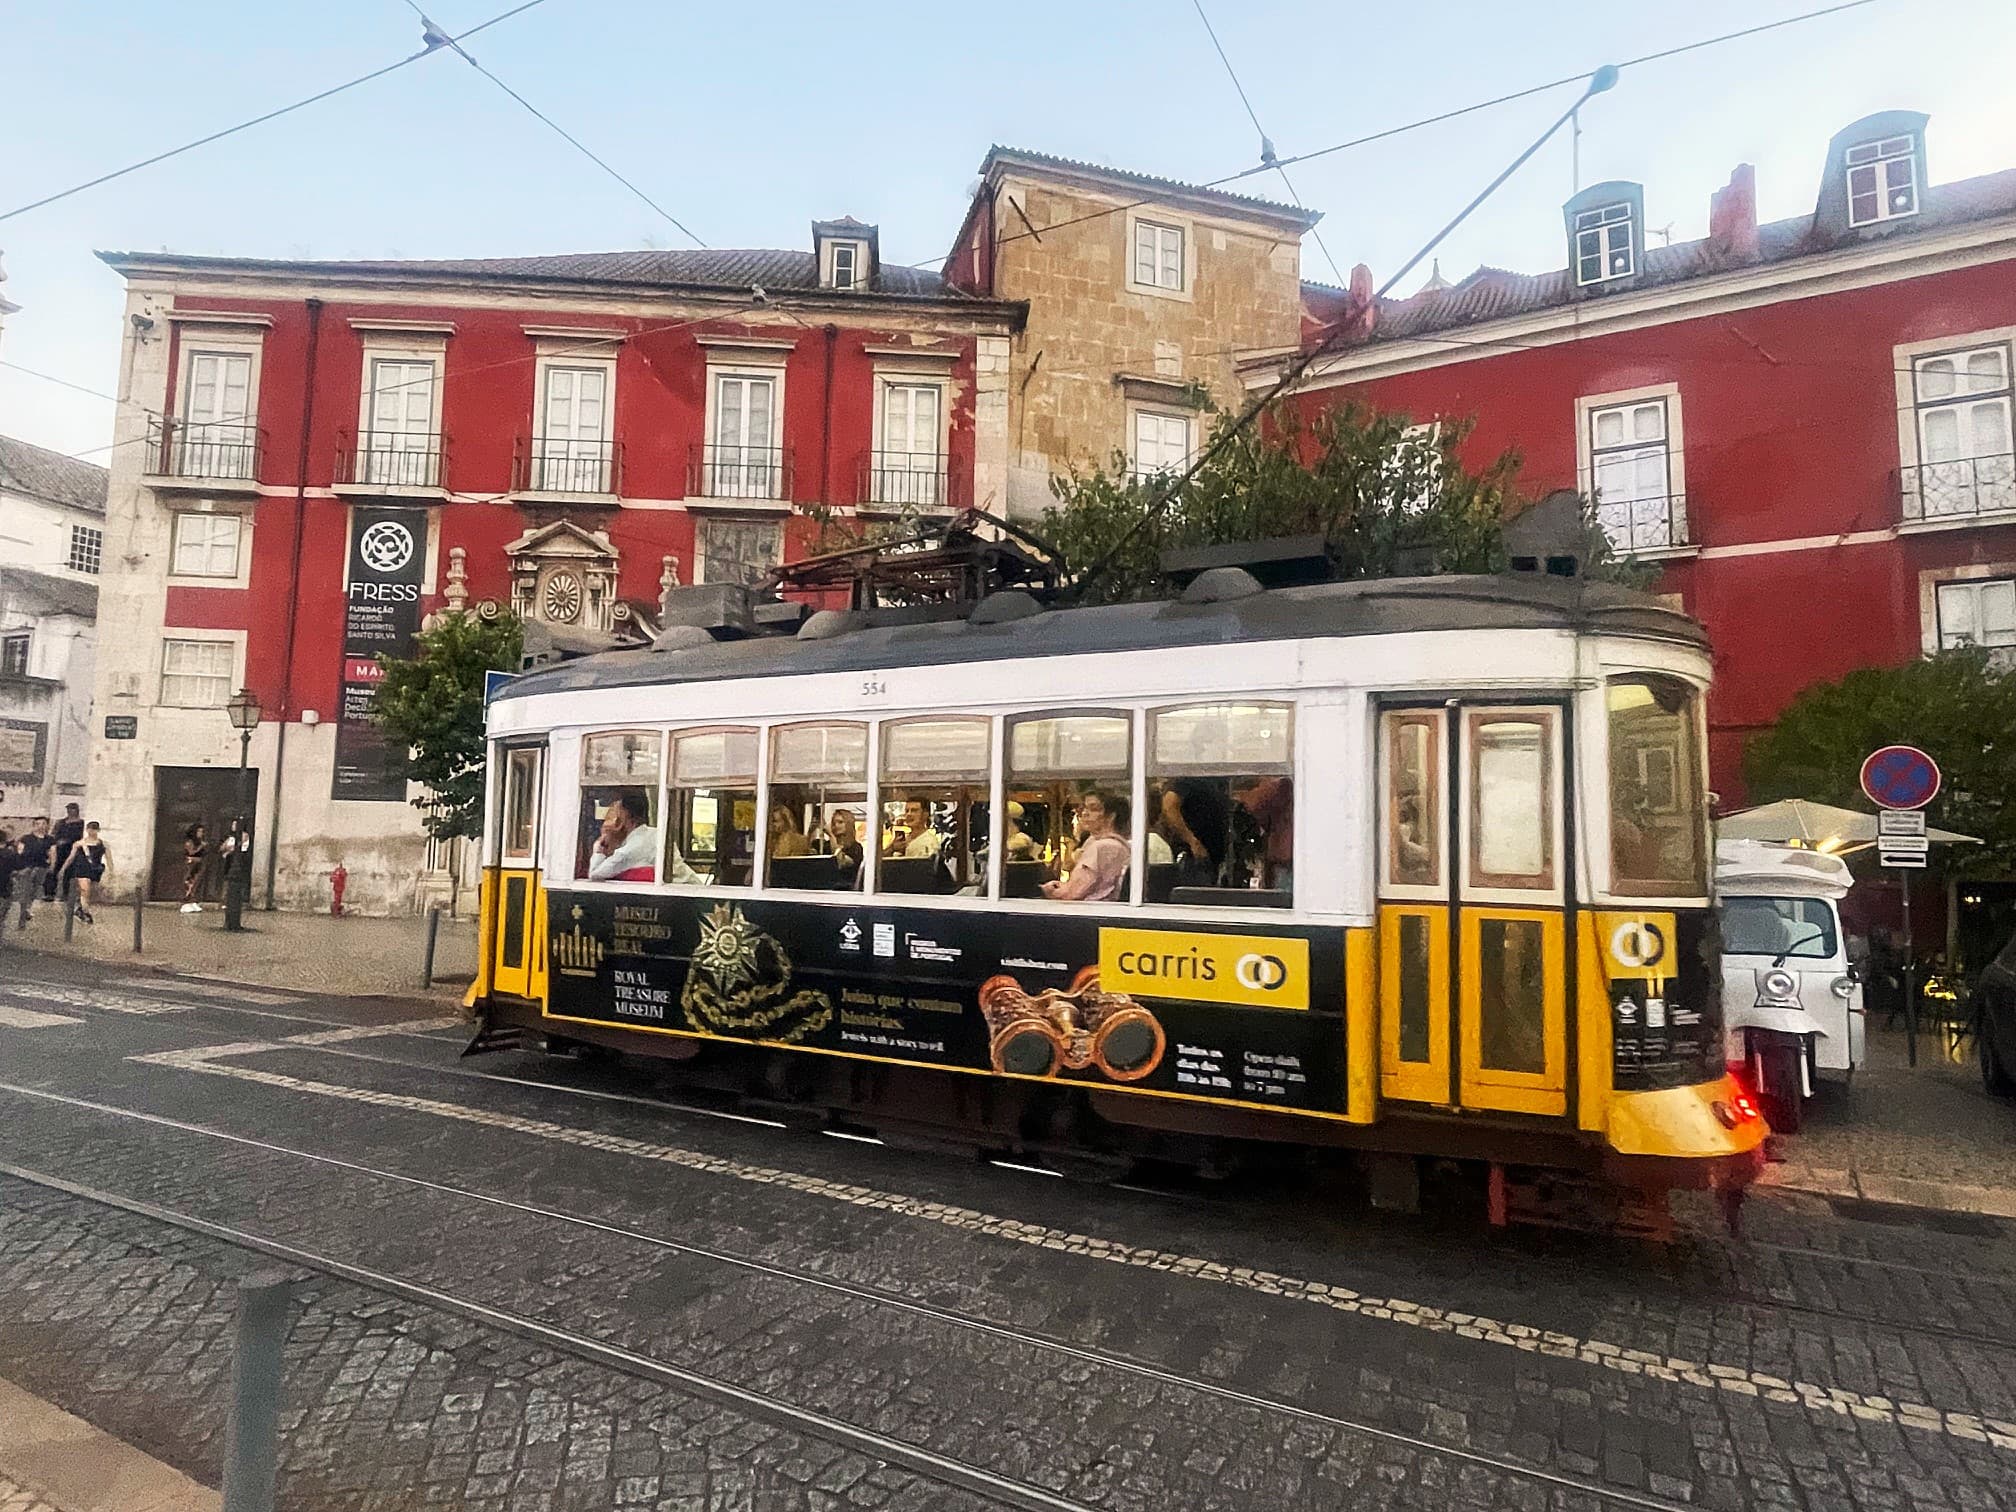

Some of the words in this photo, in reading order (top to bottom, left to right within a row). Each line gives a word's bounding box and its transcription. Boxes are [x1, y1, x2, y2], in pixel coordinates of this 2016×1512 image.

[349, 582, 418, 602] FRESS
[349, 605, 394, 614] FUNDAÇÃO
[347, 631, 373, 639] SANTO
[374, 632, 396, 640] SILVA
[345, 687, 376, 696] Museu
[861, 682, 887, 695] 554
[1118, 947, 1216, 981] carris
[614, 970, 650, 986] ROYAL
[614, 986, 671, 1004] TREASURE
[614, 1001, 664, 1019] MUSEUM
